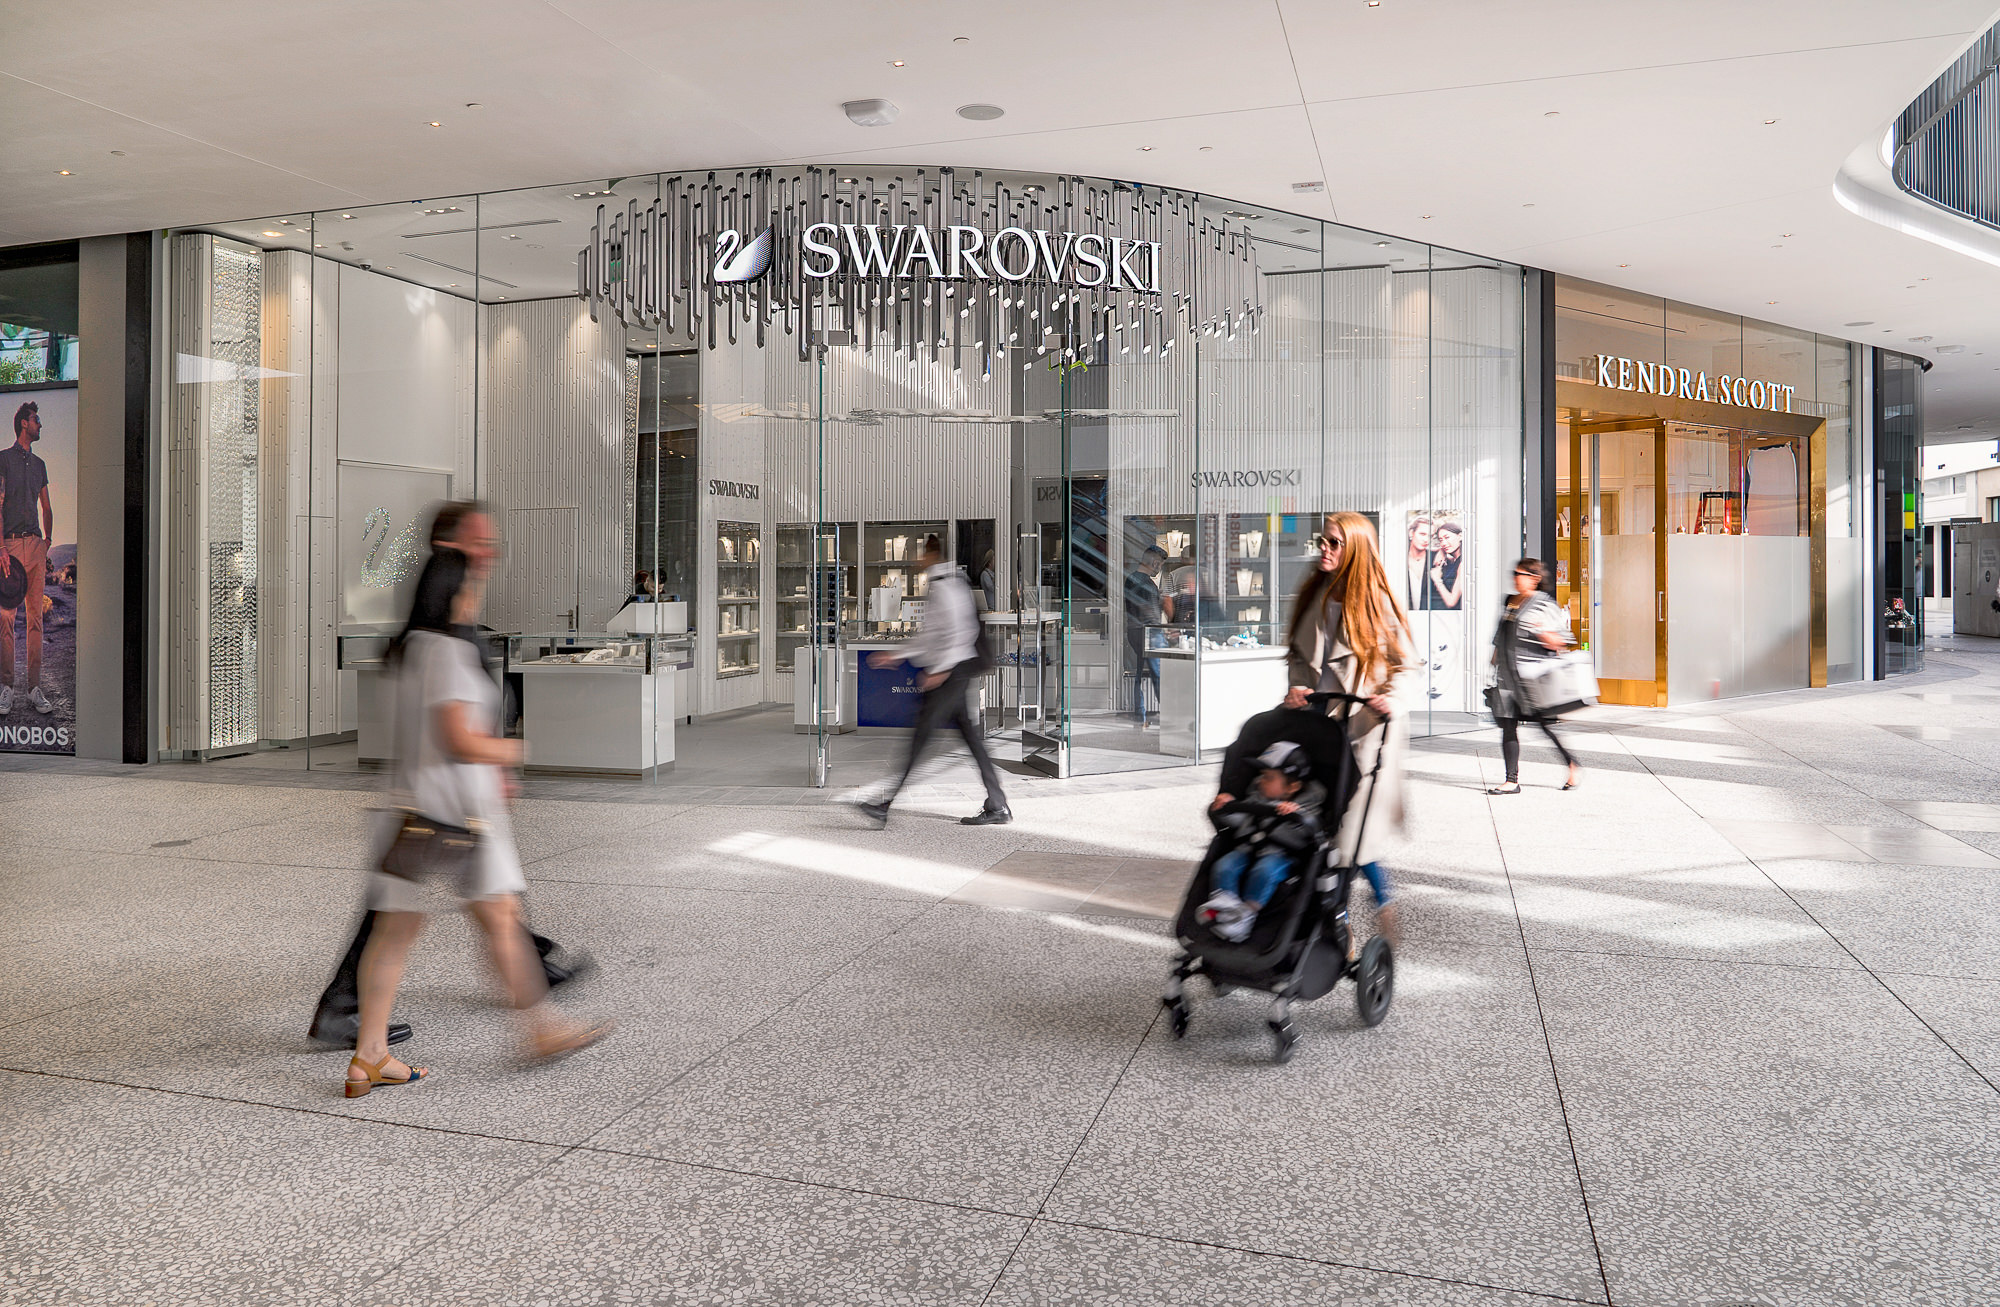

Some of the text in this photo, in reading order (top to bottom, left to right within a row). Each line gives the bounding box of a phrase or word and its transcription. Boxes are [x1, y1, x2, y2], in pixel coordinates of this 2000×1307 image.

[803, 223, 1161, 292] SWAROVSKI
[1595, 354, 1795, 413] KENDRA SCOTT
[709, 479, 760, 500] SWAROVSKI
[1191, 469, 1302, 488] SWAROVSKI
